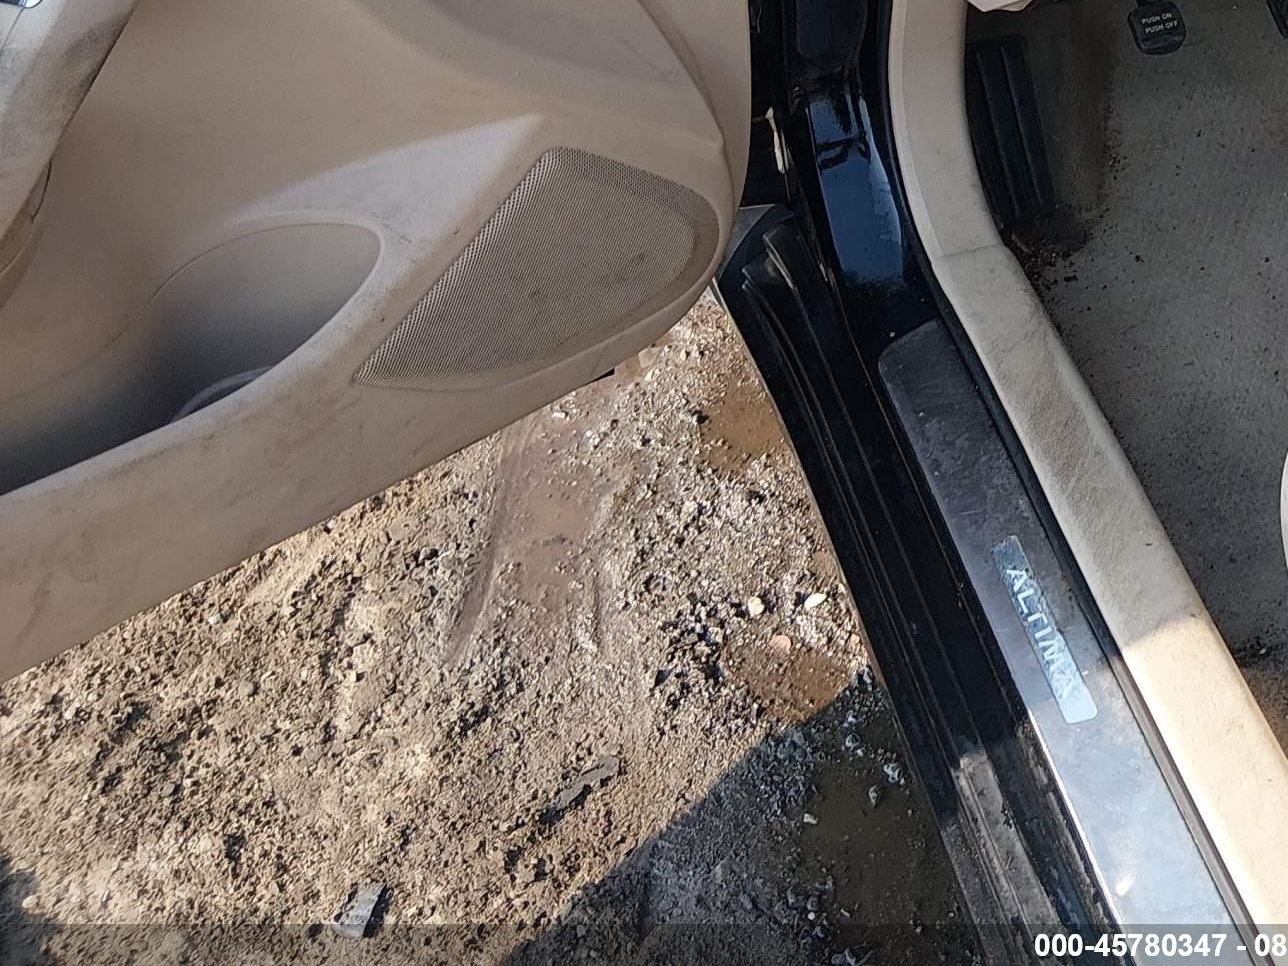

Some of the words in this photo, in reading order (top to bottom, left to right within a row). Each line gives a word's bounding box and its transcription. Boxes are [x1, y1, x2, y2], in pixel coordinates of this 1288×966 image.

[1141, 16, 1161, 25] PUSH
[1161, 12, 1173, 20] ON
[1145, 24, 1165, 34] PUSH
[1006, 568, 1074, 700] ALTIMA
